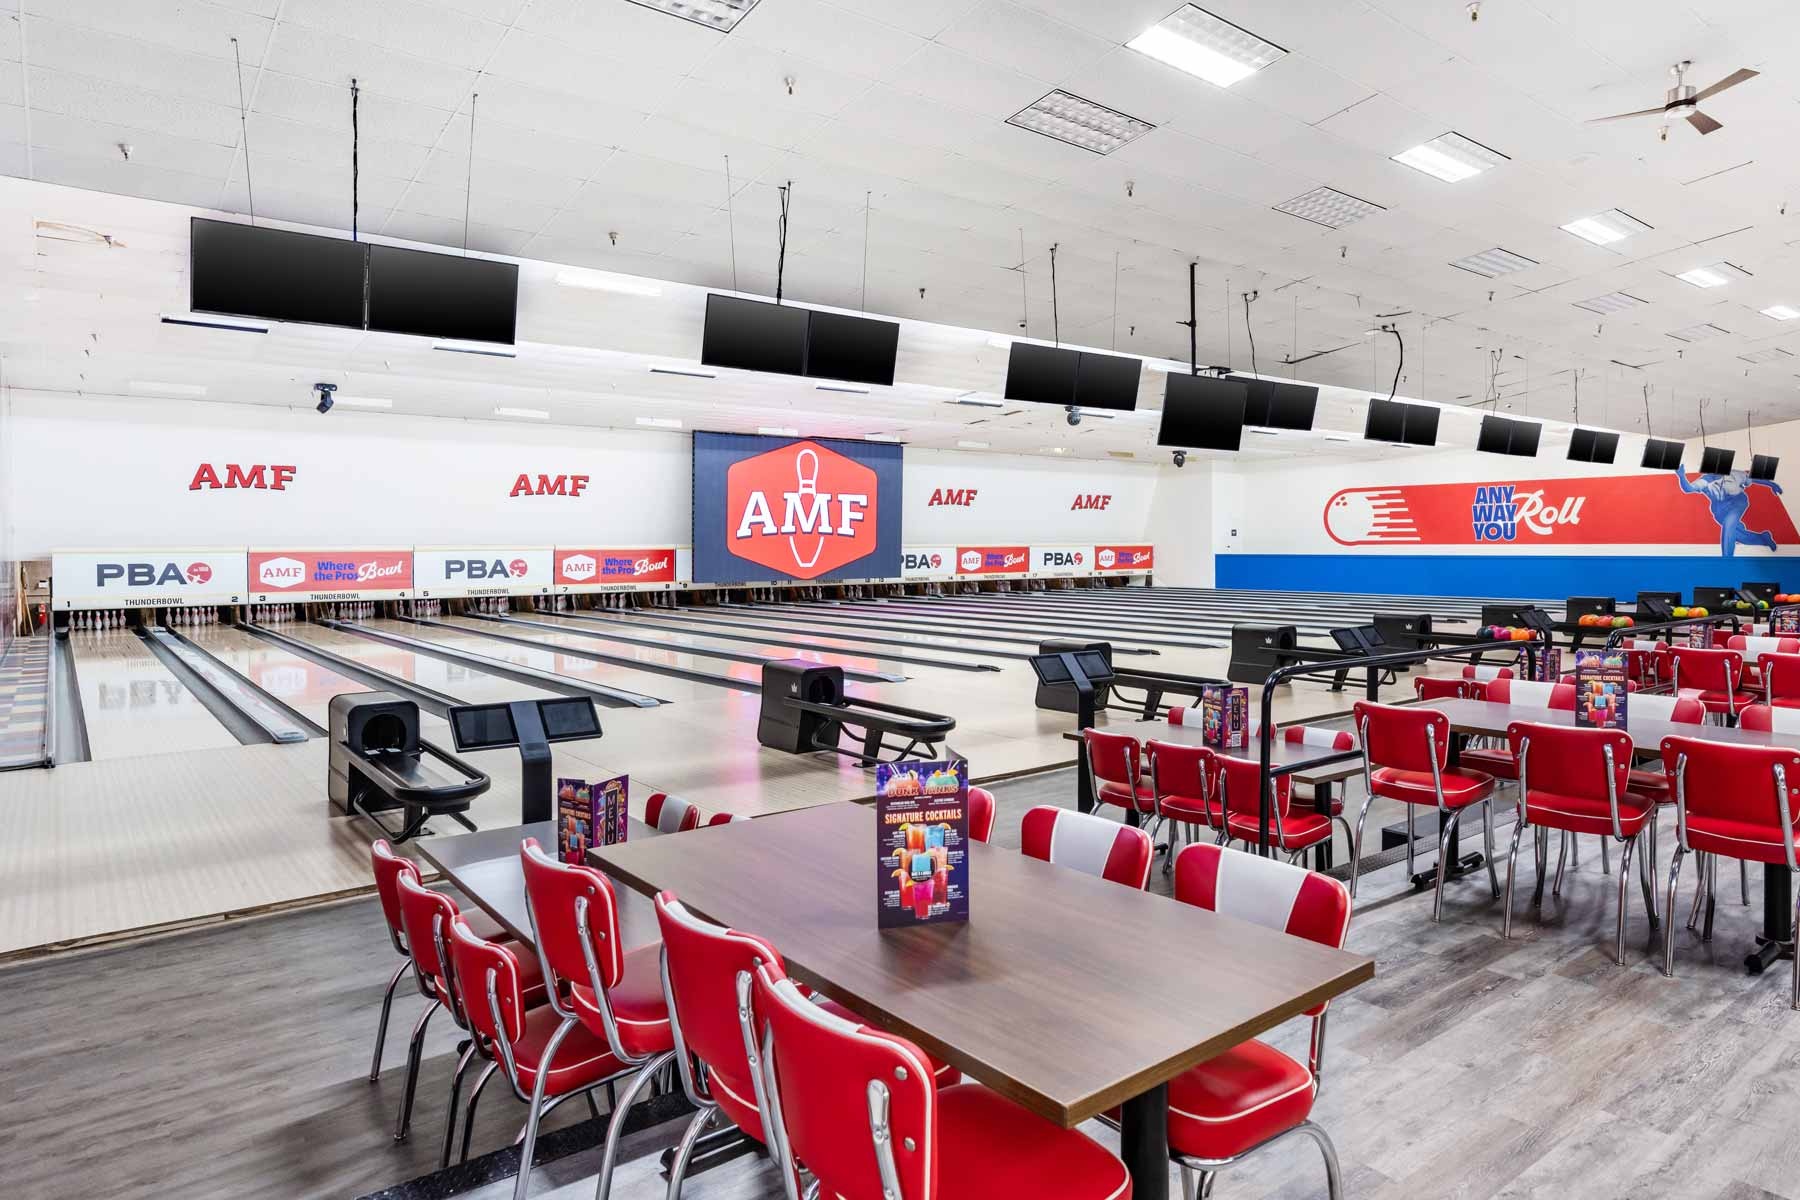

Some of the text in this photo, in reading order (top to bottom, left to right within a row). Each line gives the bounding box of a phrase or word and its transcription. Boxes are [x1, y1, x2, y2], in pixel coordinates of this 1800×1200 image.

[189, 463, 297, 491] AMF
[509, 474, 590, 497] AMF
[928, 488, 978, 506] AMF
[1071, 494, 1112, 511] AMF
[1475, 485, 1516, 505] ANY
[736, 491, 869, 539] AMF
[1472, 503, 1518, 523] WAY
[1511, 489, 1586, 535] Roll
[1472, 521, 1517, 541] YOU
[317, 560, 355, 571] Where
[604, 558, 633, 567] Where
[633, 557, 668, 576] Bowl
[963, 557, 980, 565] AMF
[1044, 552, 1074, 566] PBA
[96, 563, 188, 587] PBA
[263, 567, 302, 578] AMF
[314, 570, 358, 581] the Pros
[356, 560, 403, 583] Bowl
[445, 559, 510, 579] PBA
[565, 563, 593, 573] AMF
[602, 566, 636, 575] the Pros
[310, 593, 361, 601] THUNDERBOWL
[467, 588, 510, 596] THUNDERBOWL
[125, 597, 184, 607] THUNDERBOWL
[607, 794, 616, 844] MENU
[884, 808, 962, 824] SIGNATURE COCKTAILS
